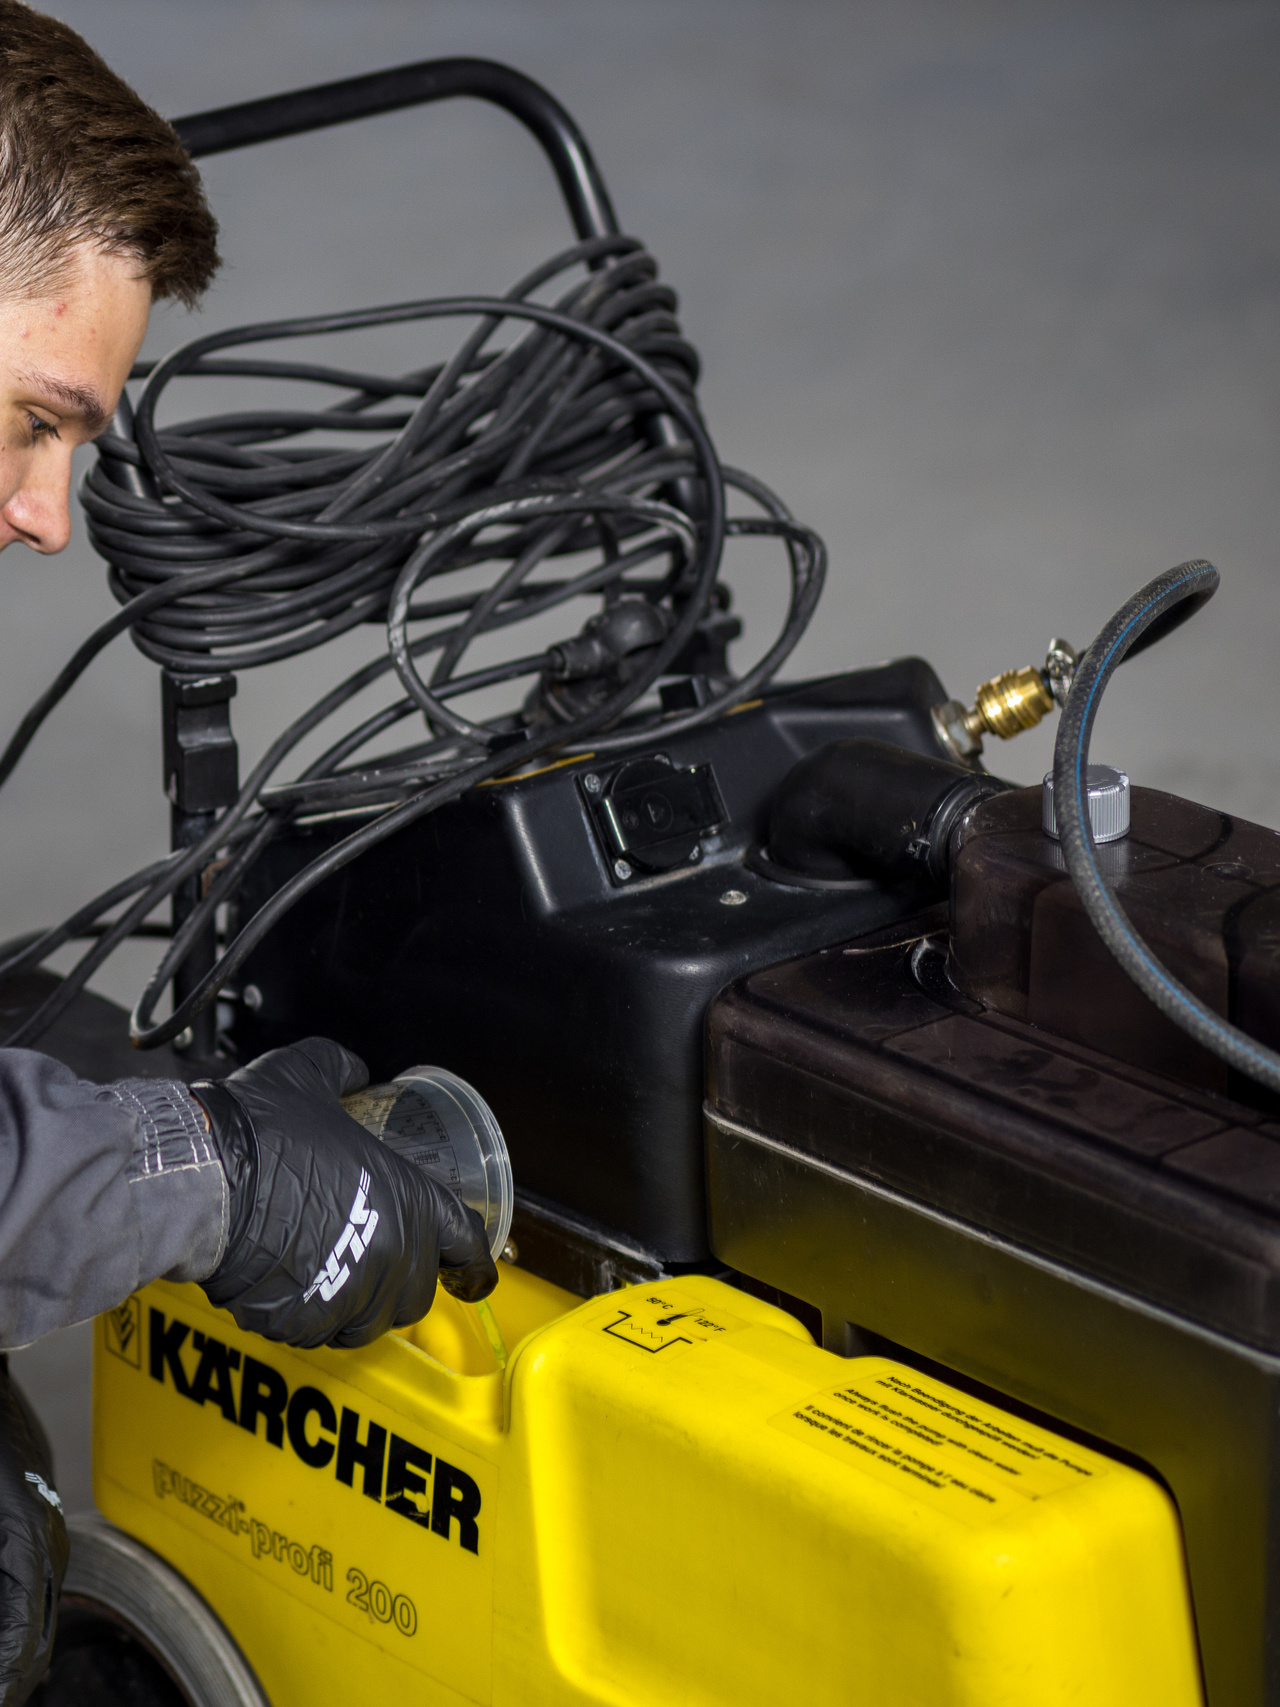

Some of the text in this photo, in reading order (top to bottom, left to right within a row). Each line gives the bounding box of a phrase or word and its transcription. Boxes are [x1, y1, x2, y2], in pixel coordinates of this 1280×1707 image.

[810, 1408, 853, 1431] convient
[832, 1391, 857, 1404] once
[856, 1402, 881, 1416] work
[843, 1388, 879, 1406] Always
[901, 1415, 919, 1425] the
[148, 1306, 483, 1556] KÄRCHER
[791, 1410, 829, 1431] lorsque
[826, 1427, 843, 1438] les
[152, 1457, 334, 1593] puzzi-profi
[345, 1566, 418, 1637] 200
